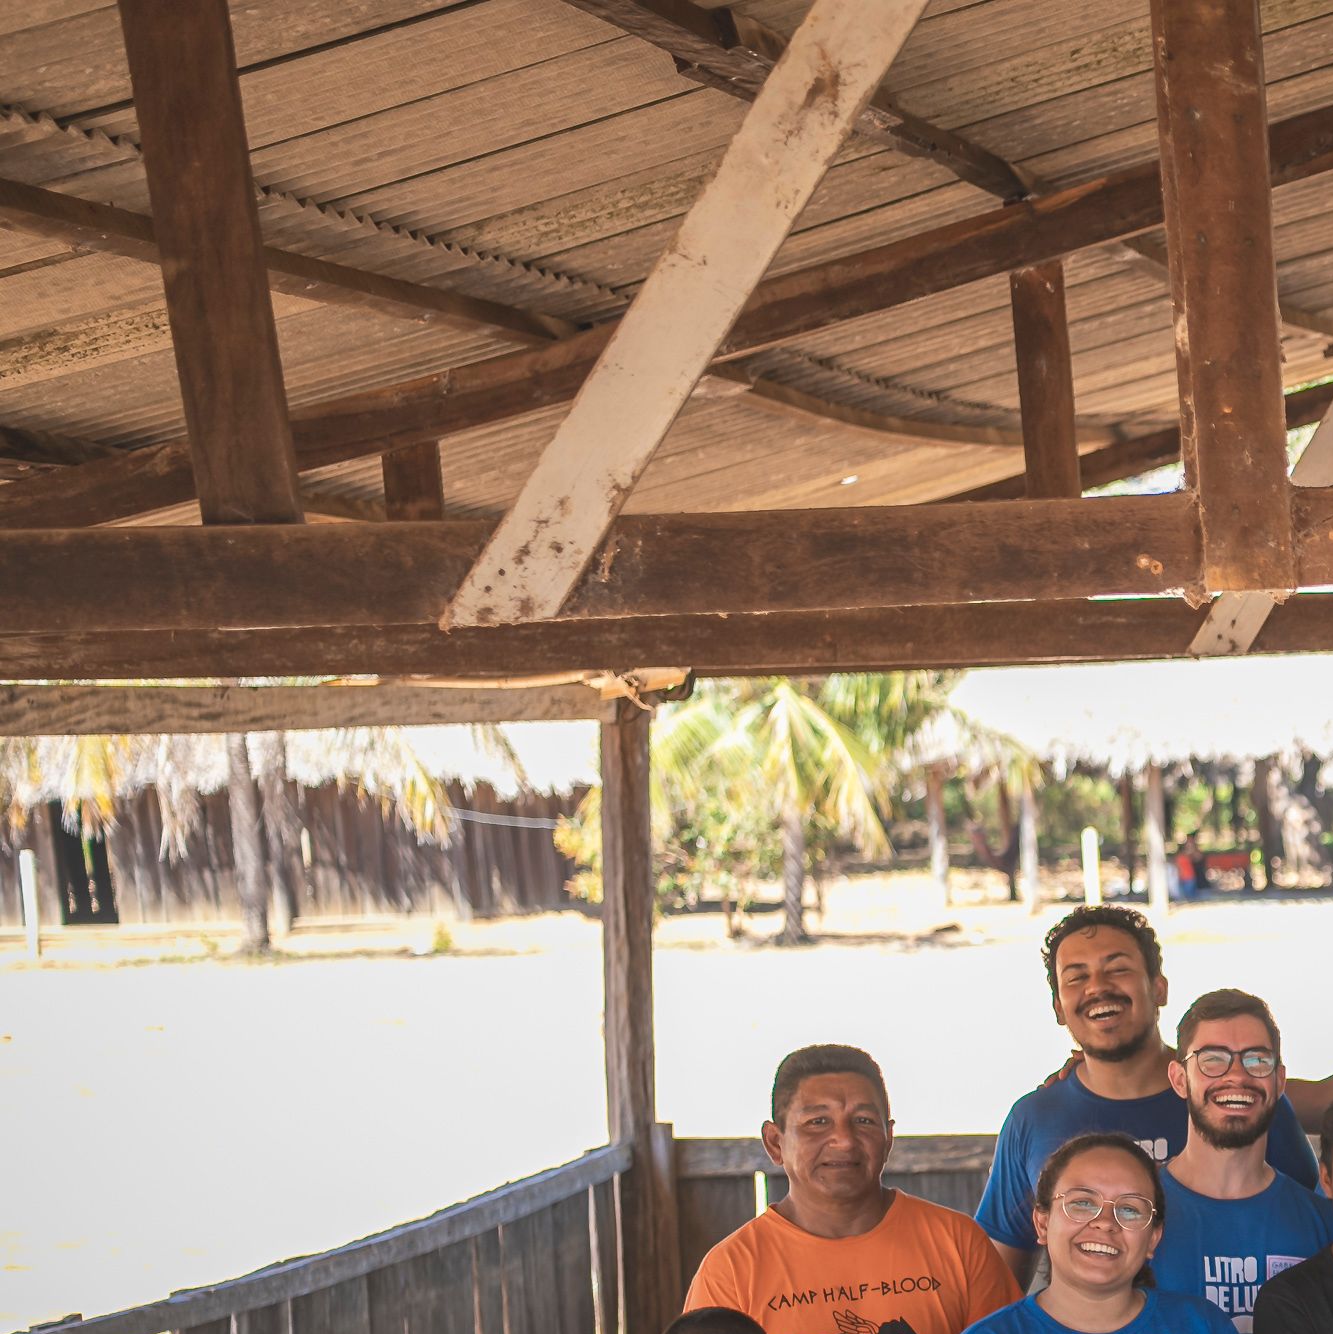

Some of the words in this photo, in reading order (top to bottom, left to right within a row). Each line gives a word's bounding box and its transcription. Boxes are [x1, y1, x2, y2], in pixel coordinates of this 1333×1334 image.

[1204, 1256, 1258, 1284] LITRO
[767, 1290, 817, 1311] CAMP
[823, 1277, 941, 1303] HALF-BLOOD
[1233, 1285, 1262, 1312] LU
